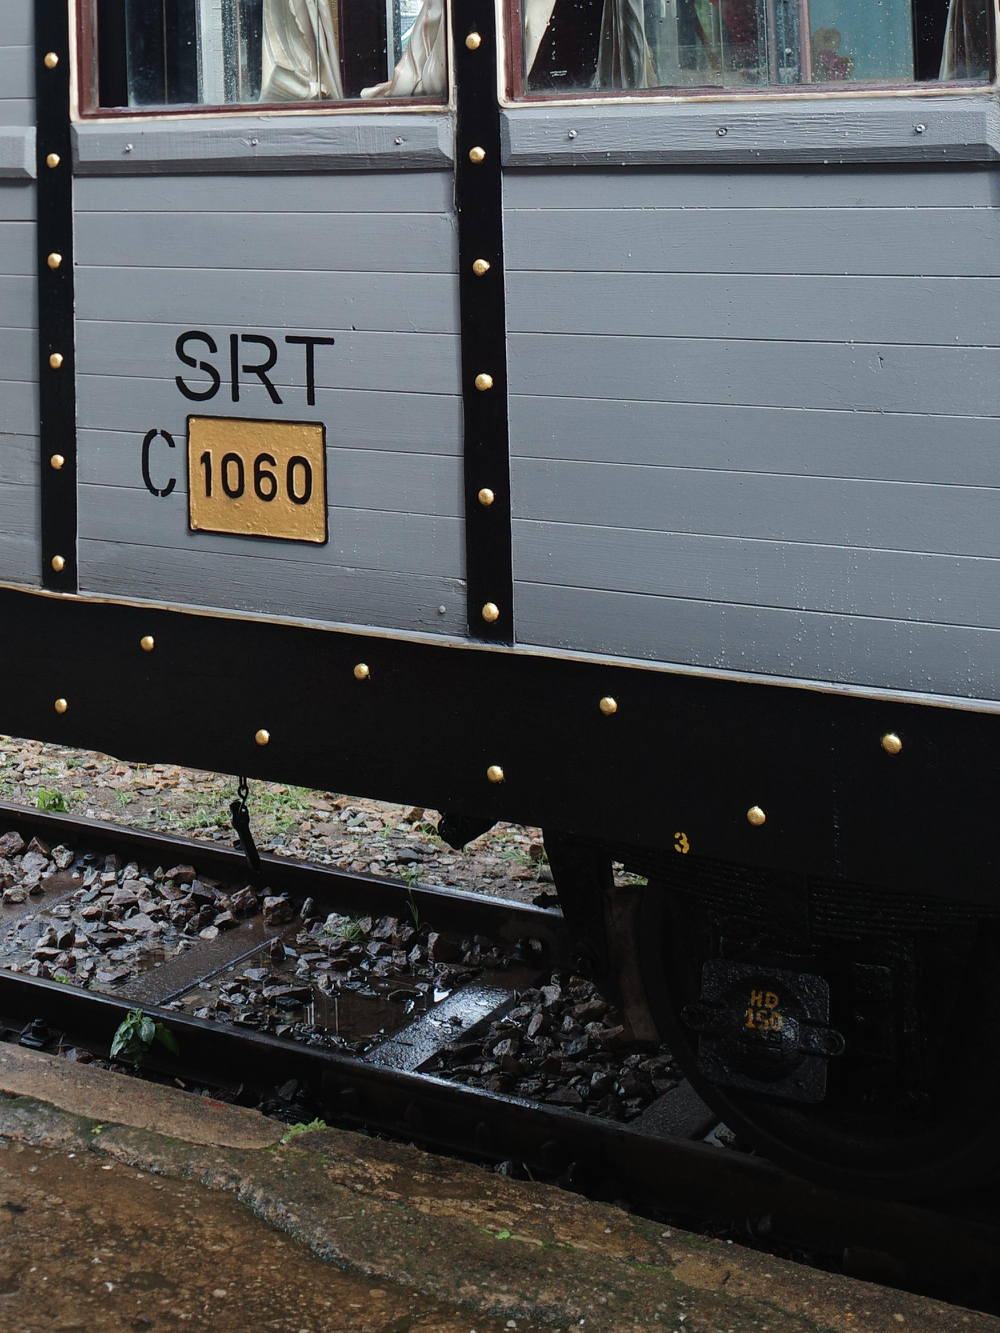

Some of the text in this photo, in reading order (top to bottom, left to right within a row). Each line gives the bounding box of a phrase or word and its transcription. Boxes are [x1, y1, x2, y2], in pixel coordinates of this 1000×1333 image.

[175, 330, 335, 406] SRT
[141, 428, 313, 505] C 1060
[674, 831, 690, 854] 3
